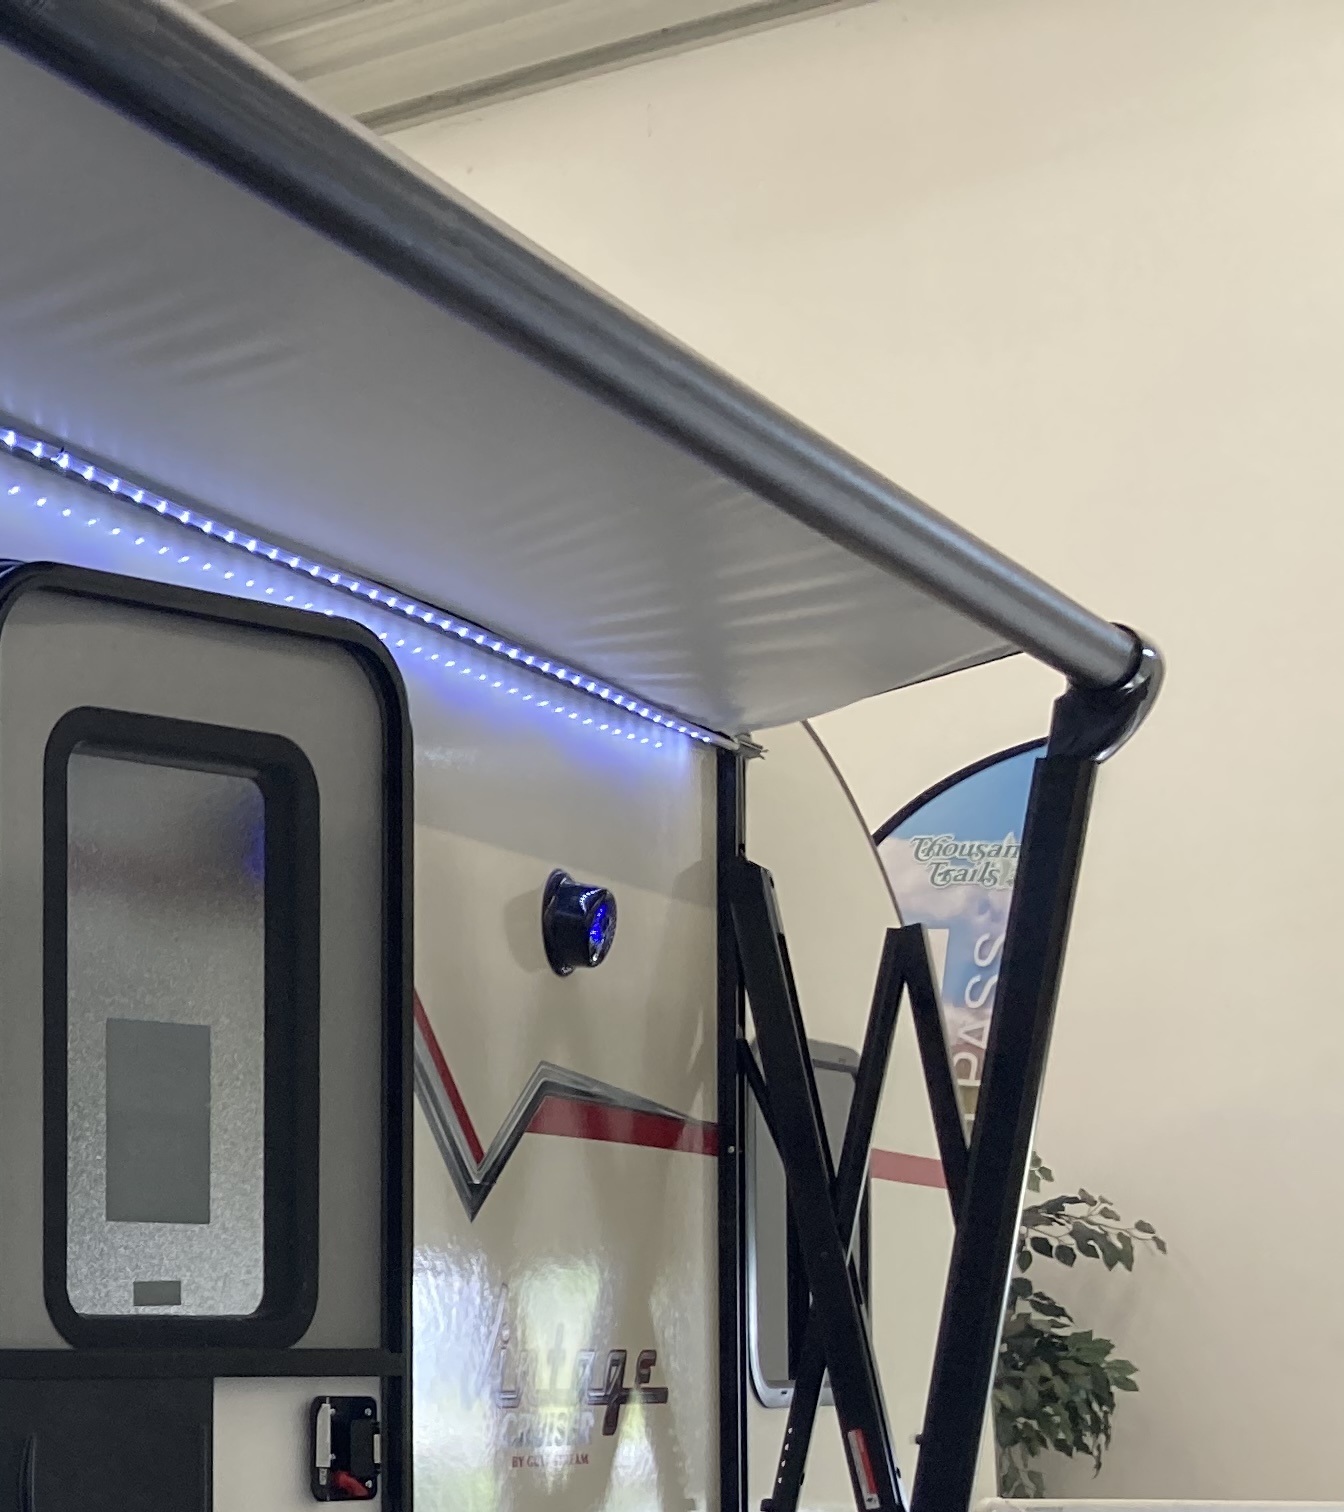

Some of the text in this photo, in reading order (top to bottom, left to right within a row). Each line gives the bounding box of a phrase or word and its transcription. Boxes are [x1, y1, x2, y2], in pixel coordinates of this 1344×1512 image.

[911, 835, 1019, 862] Thousan
[928, 861, 1000, 887] Trails
[511, 1455, 525, 1469] BY
